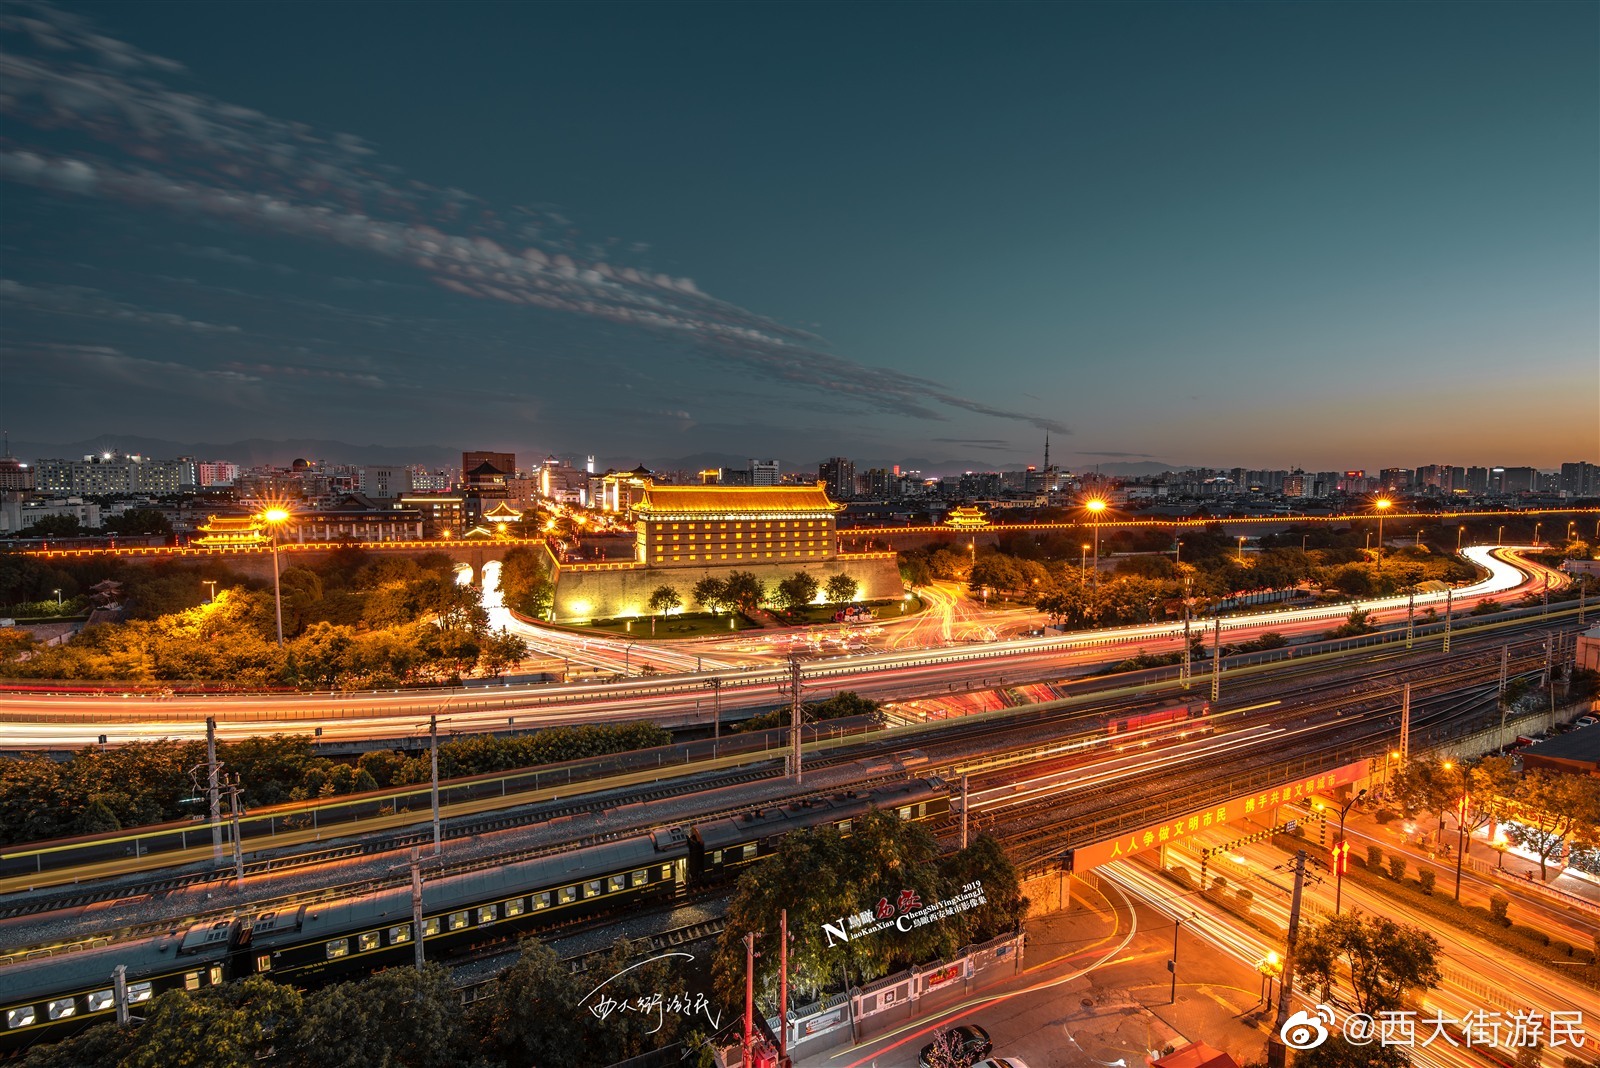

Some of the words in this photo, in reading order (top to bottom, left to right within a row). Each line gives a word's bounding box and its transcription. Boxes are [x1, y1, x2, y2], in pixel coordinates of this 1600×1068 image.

[1110, 807, 1226, 858] 人人争做文明市民
[1245, 773, 1336, 813] 携手共建文明城市
